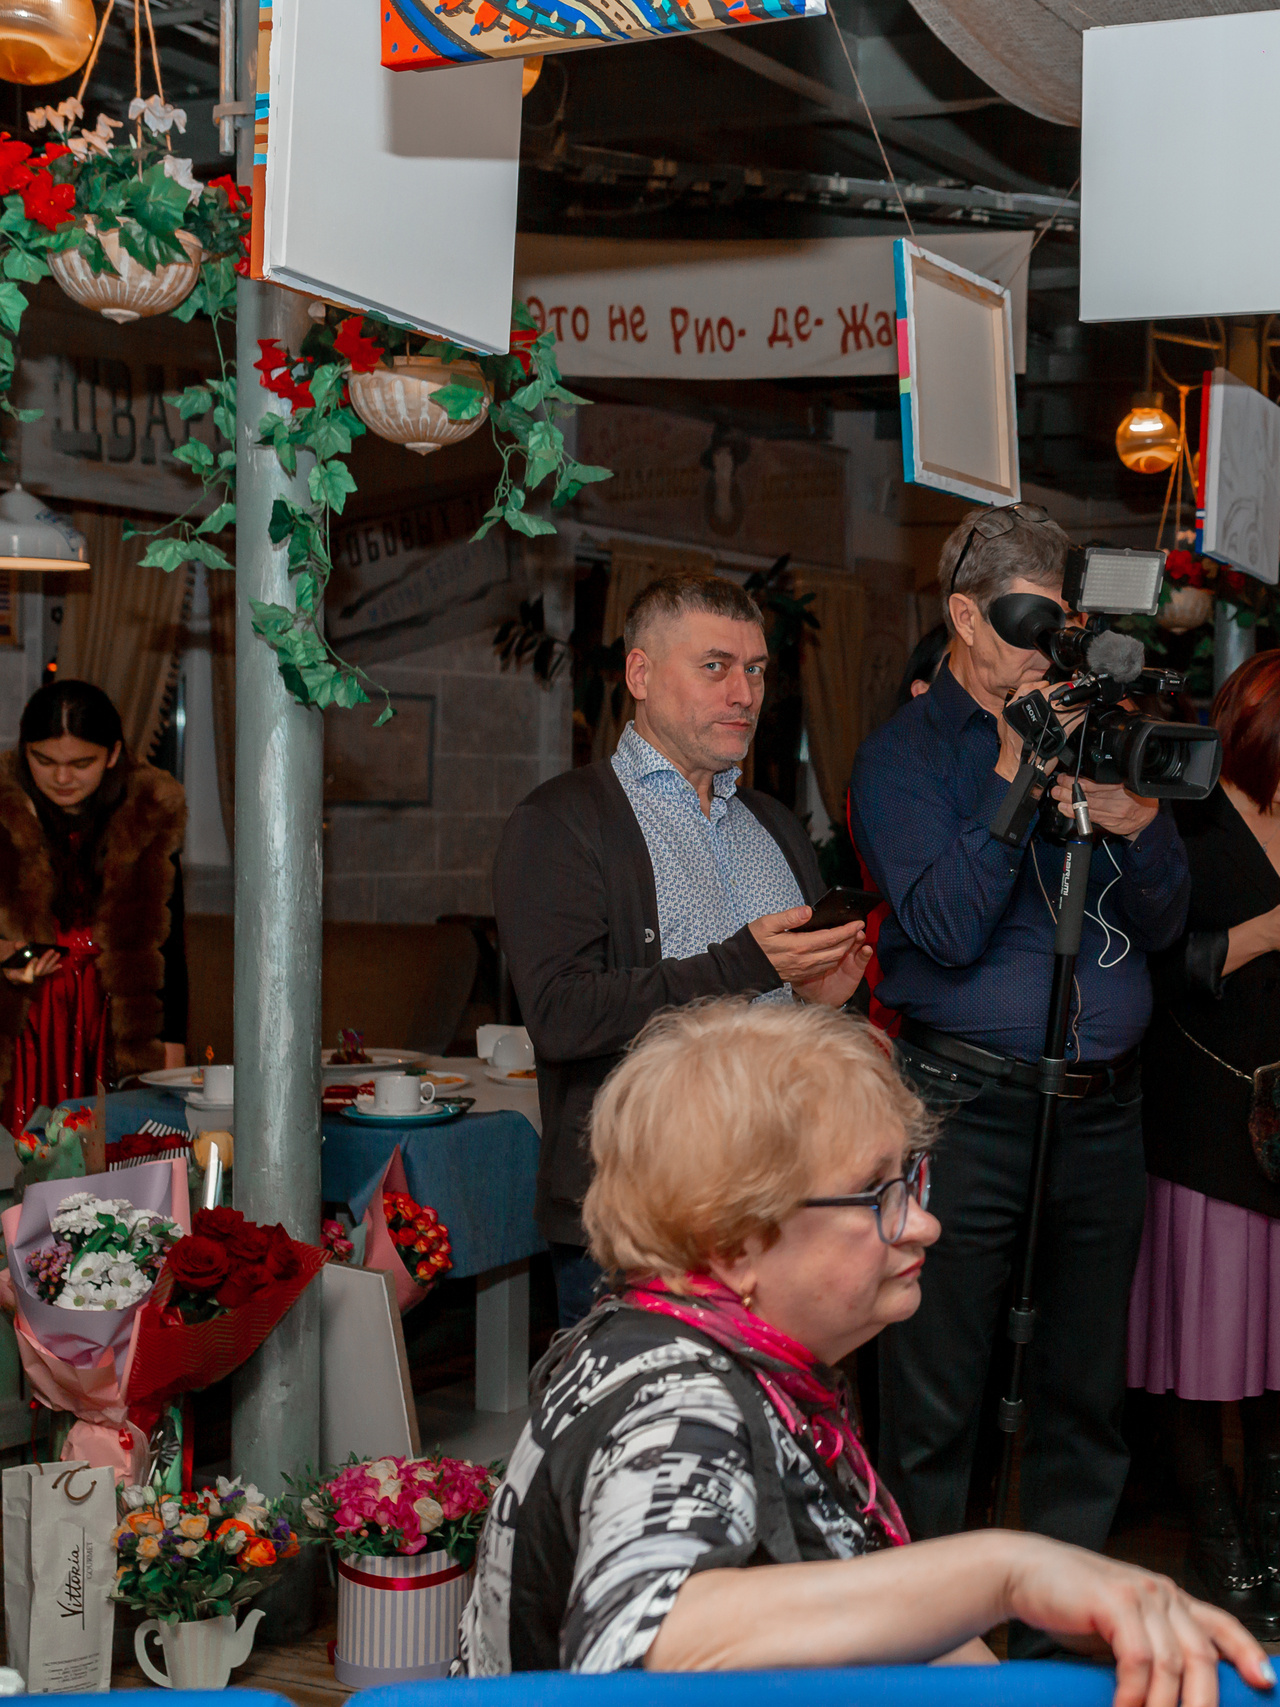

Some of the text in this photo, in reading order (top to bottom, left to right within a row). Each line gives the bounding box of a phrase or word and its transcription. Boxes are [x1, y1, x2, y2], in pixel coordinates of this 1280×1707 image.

[608, 303, 648, 343] не
[669, 306, 747, 355] Рио-
[767, 305, 824, 349] де-
[837, 302, 897, 355] Жа
[86, 1541, 94, 1580] GOURMET
